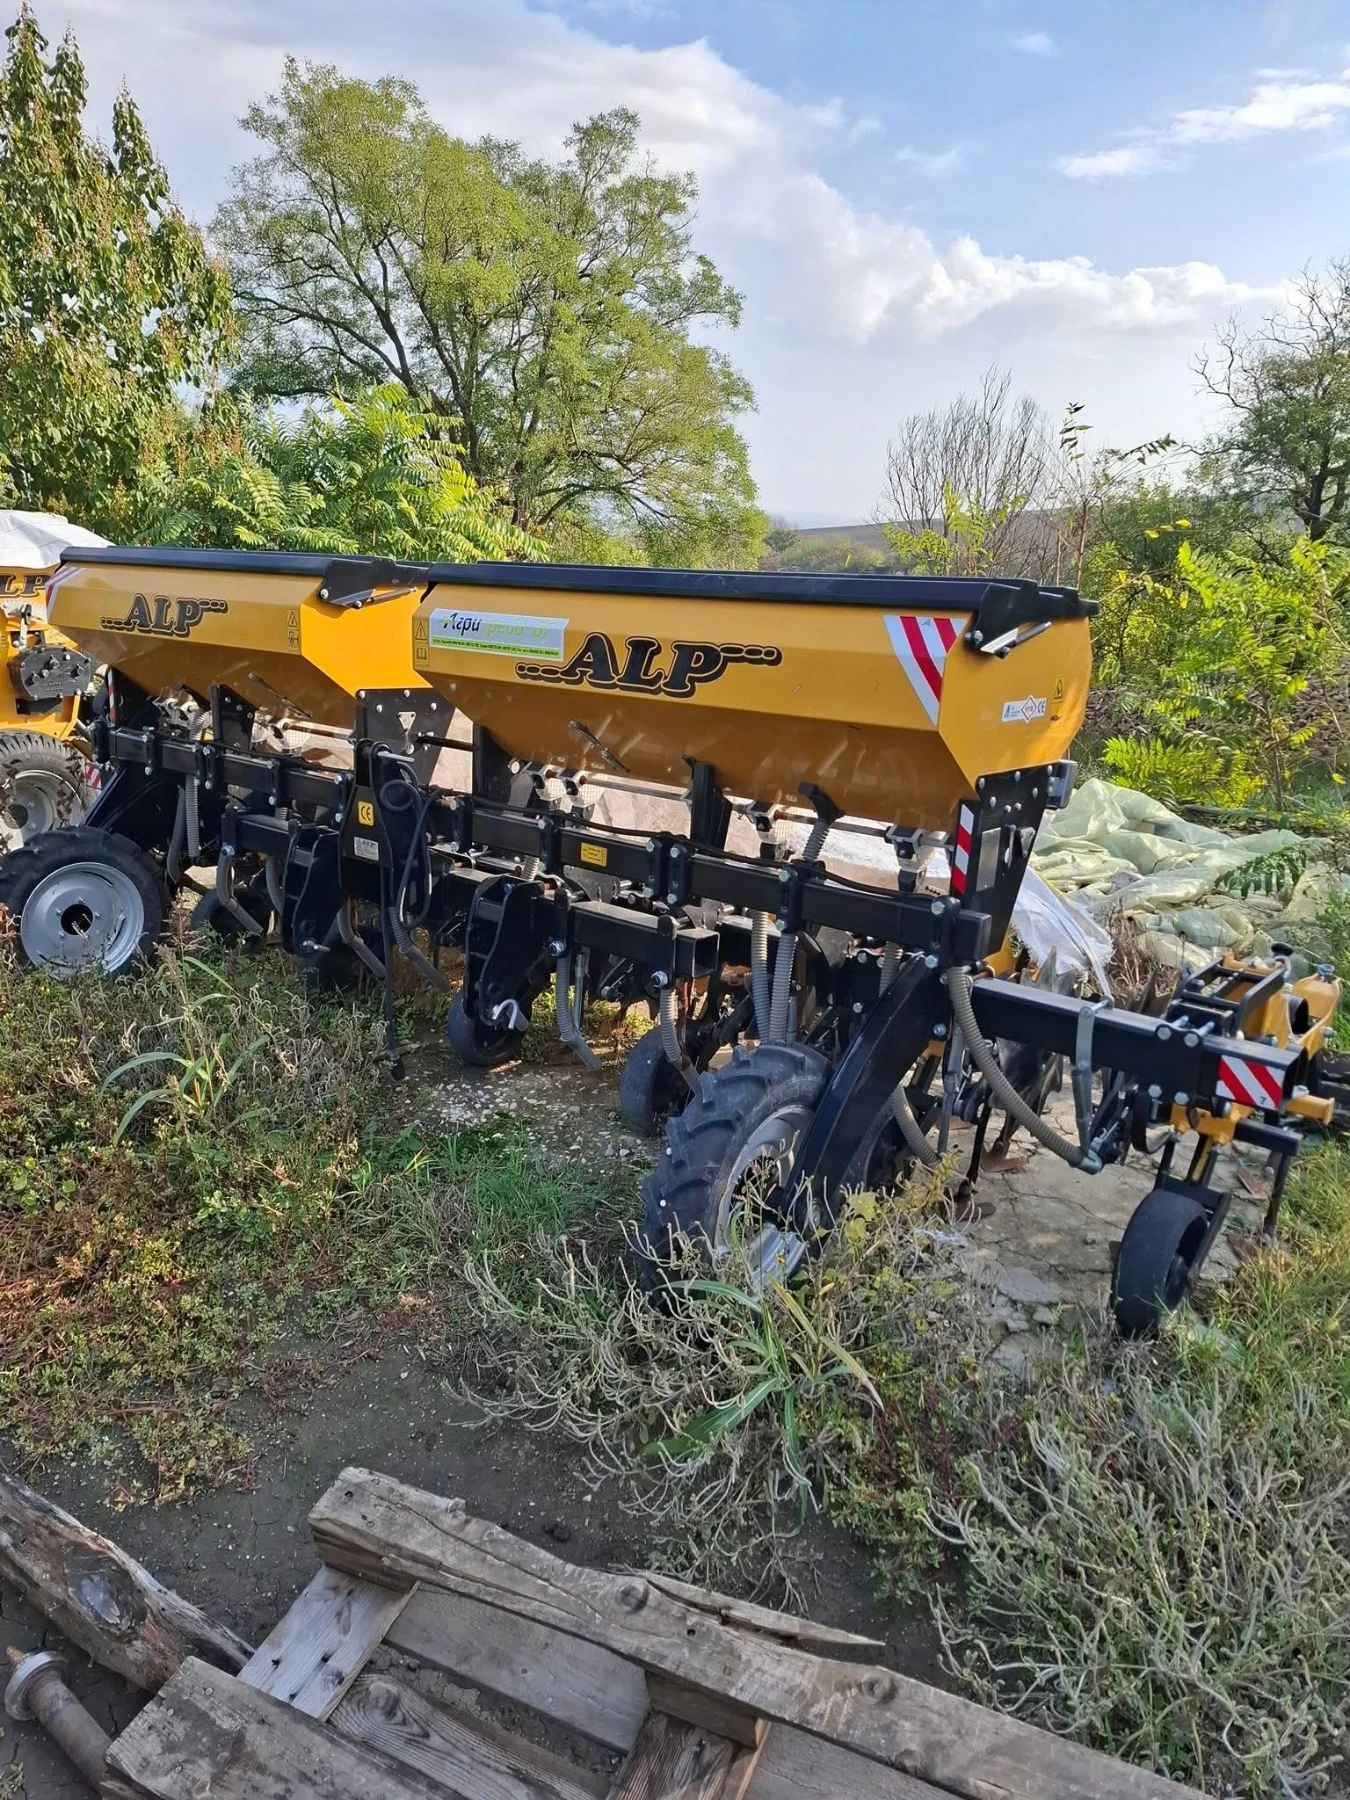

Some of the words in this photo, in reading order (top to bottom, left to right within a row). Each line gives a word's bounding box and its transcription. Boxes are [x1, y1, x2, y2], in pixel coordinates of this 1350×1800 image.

[119, 592, 205, 638] ALP
[556, 631, 732, 698] ALP
[360, 805, 372, 822] CE
